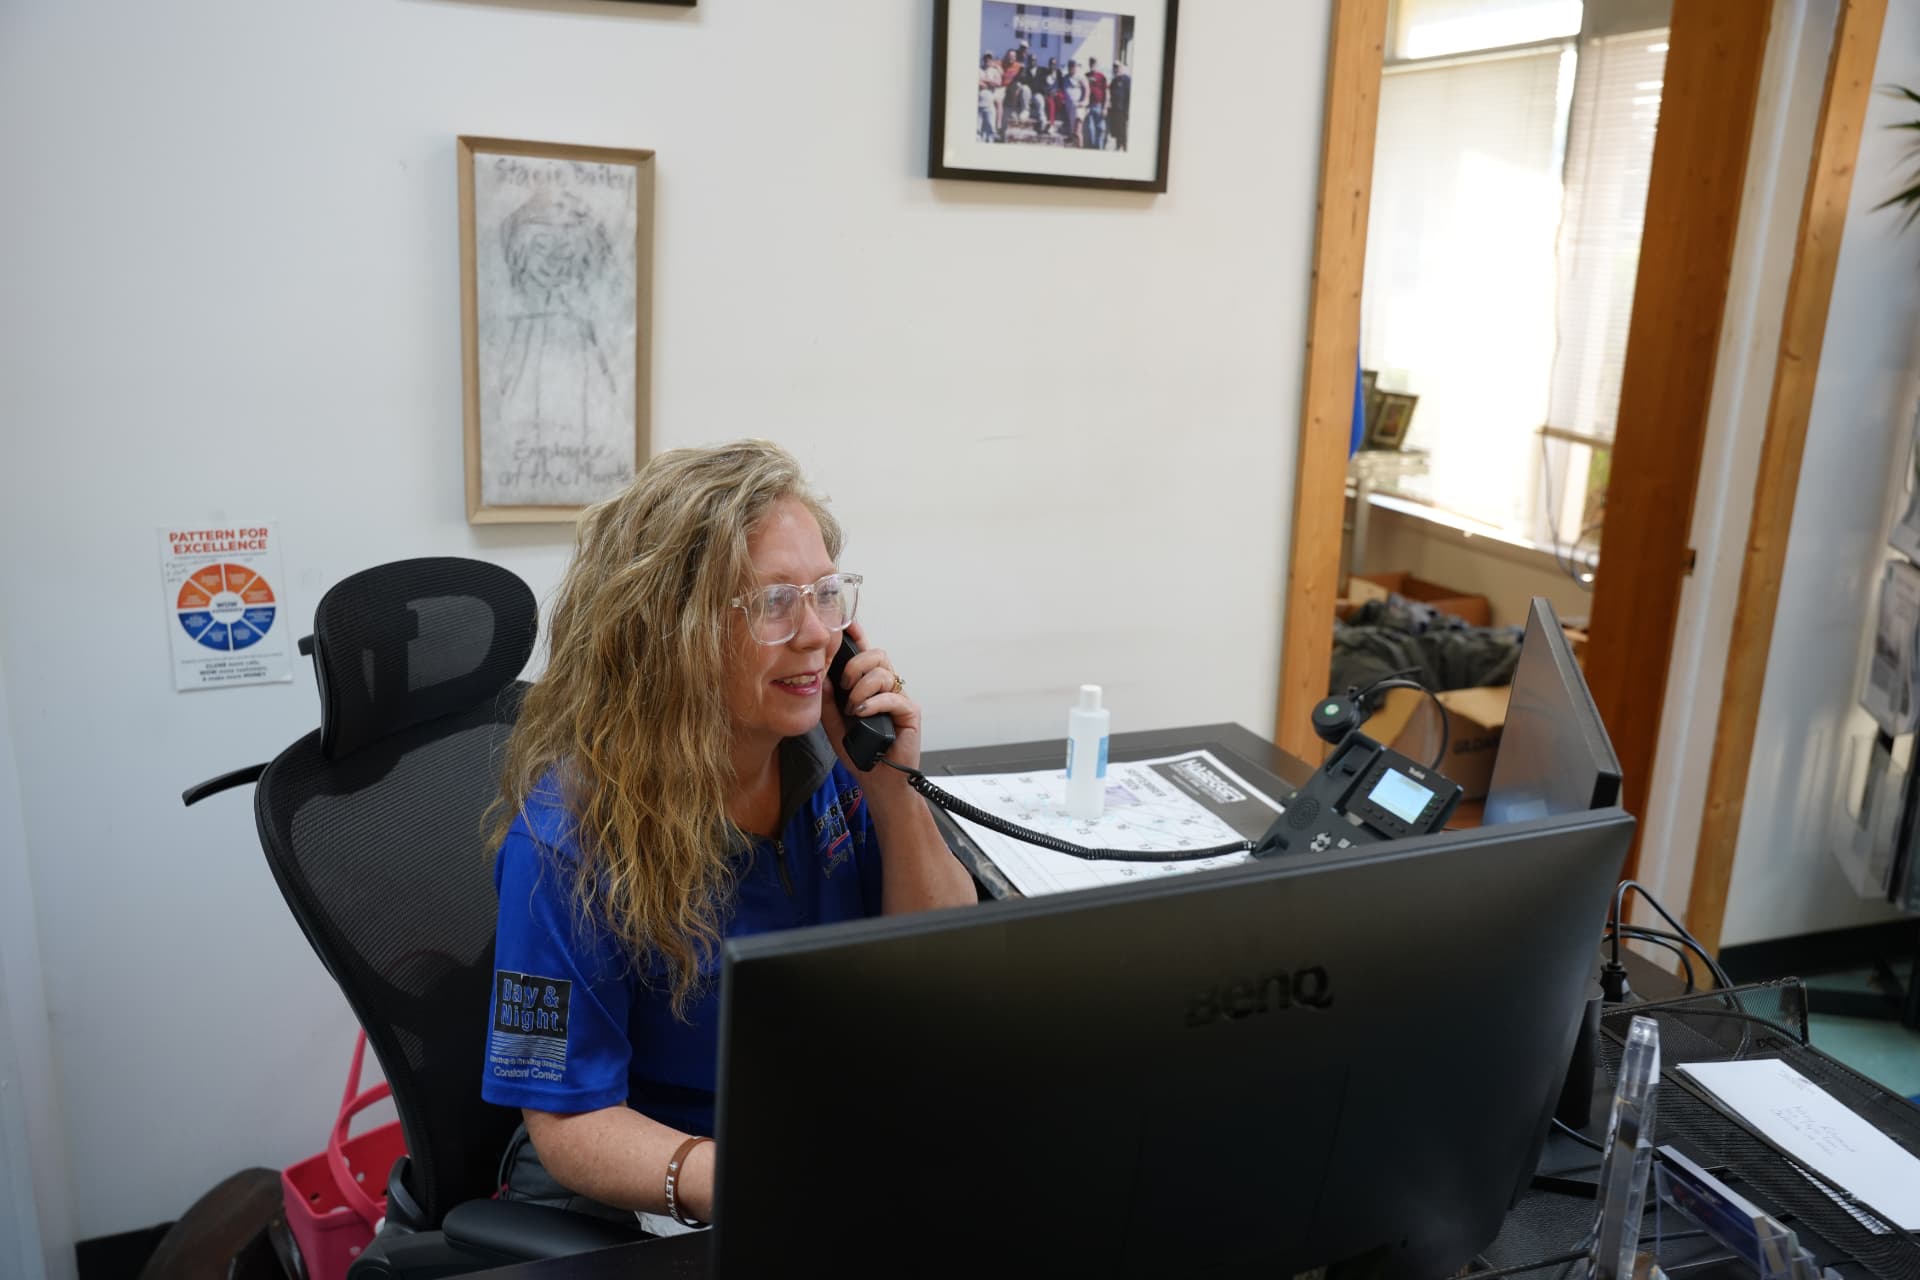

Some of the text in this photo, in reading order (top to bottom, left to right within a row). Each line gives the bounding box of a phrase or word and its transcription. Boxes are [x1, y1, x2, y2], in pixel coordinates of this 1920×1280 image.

[169, 527, 269, 543] PATTERN FOR
[173, 539, 267, 555] EXCELLENCE
[503, 978, 560, 1009] Day &
[1184, 965, 1334, 1032] BenQ
[494, 1065, 563, 1083] Constant Comfort
[665, 1175, 675, 1202] LET
